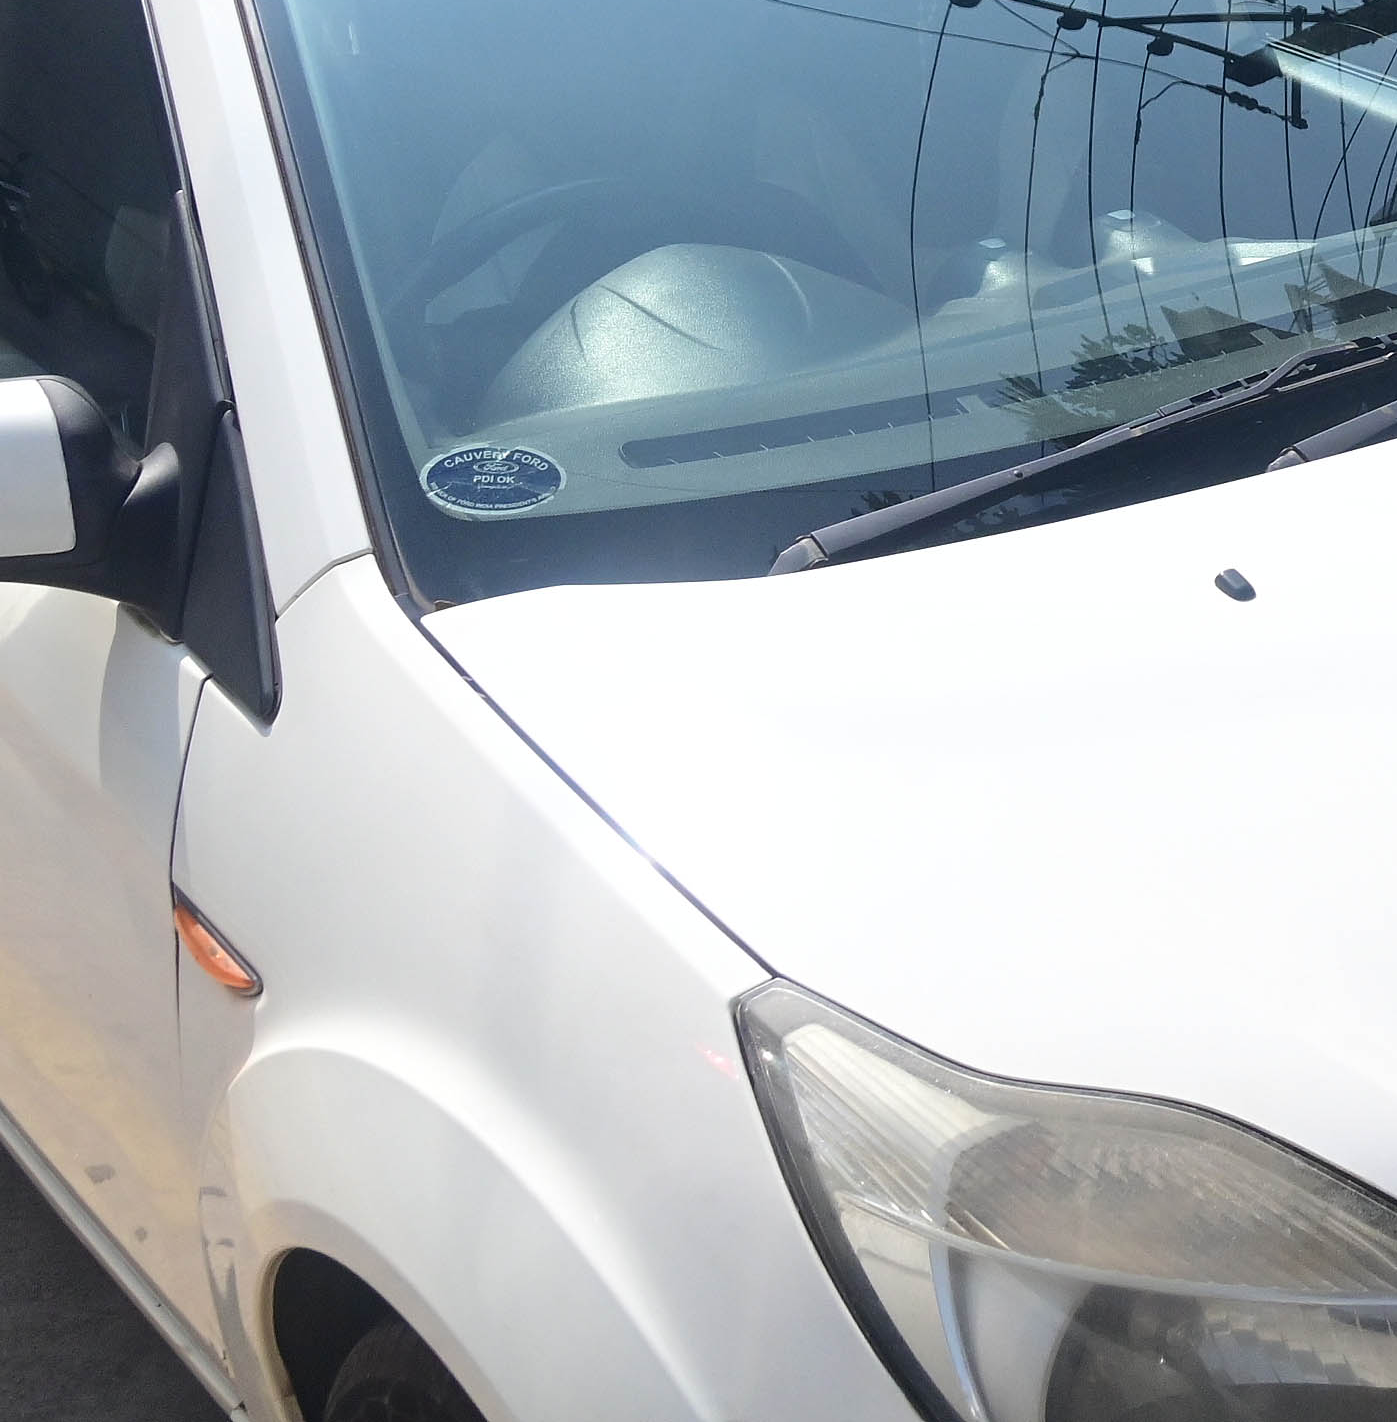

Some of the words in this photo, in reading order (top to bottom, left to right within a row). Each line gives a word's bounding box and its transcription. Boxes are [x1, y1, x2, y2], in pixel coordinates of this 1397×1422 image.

[513, 452, 549, 472] FORD
[473, 475, 494, 483] PDI
[497, 475, 516, 484] OK
